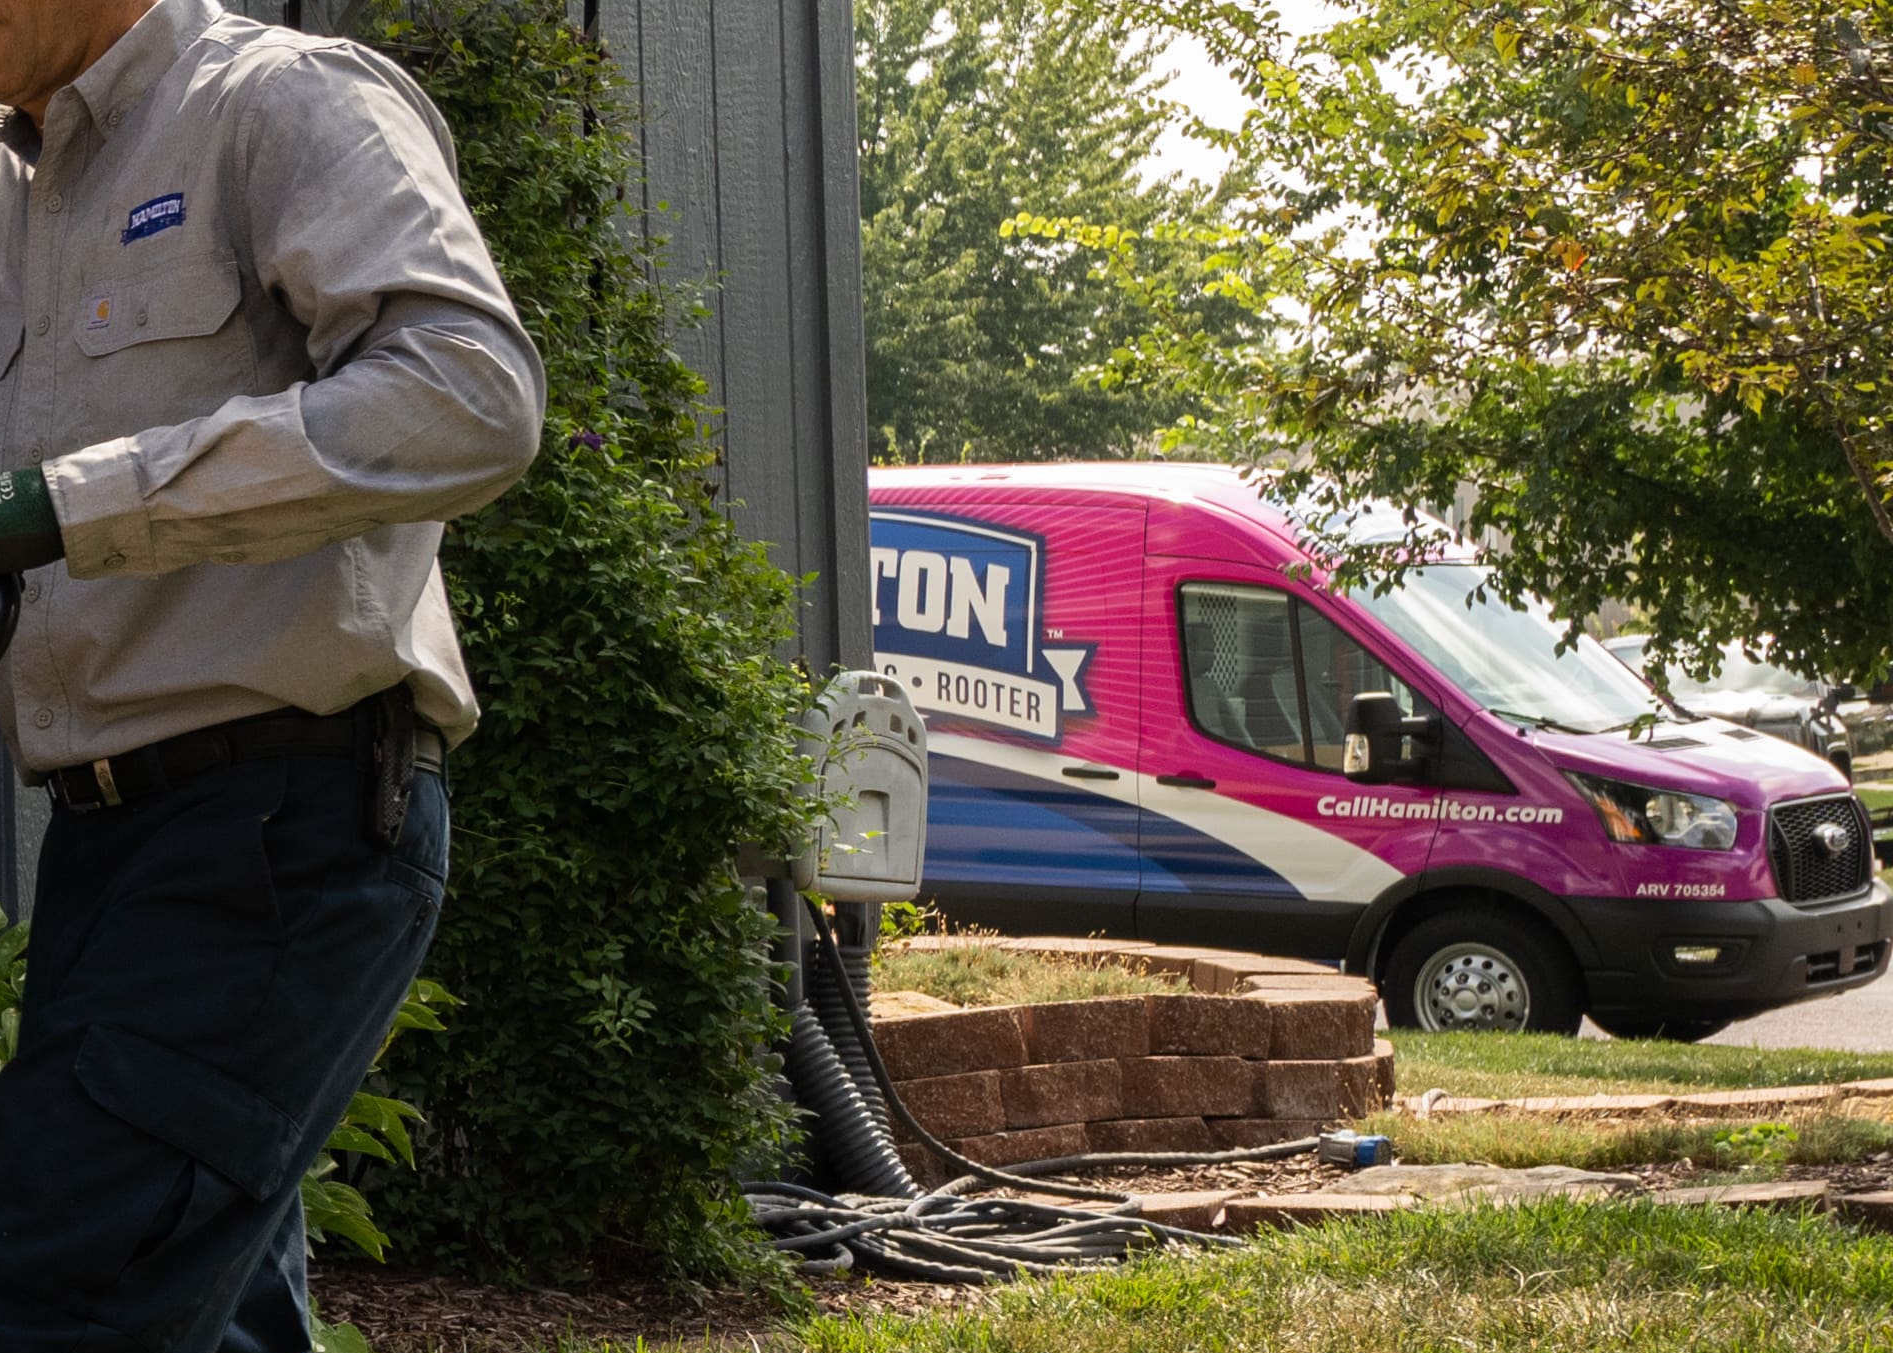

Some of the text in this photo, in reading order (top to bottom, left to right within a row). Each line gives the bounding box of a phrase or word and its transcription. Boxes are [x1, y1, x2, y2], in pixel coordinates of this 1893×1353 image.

[131, 199, 181, 228] HAMILTON
[937, 671, 1041, 723] ROOTER
[1317, 796, 1563, 823] CallHamilton.com
[1636, 883, 1725, 897] ARV 705354
